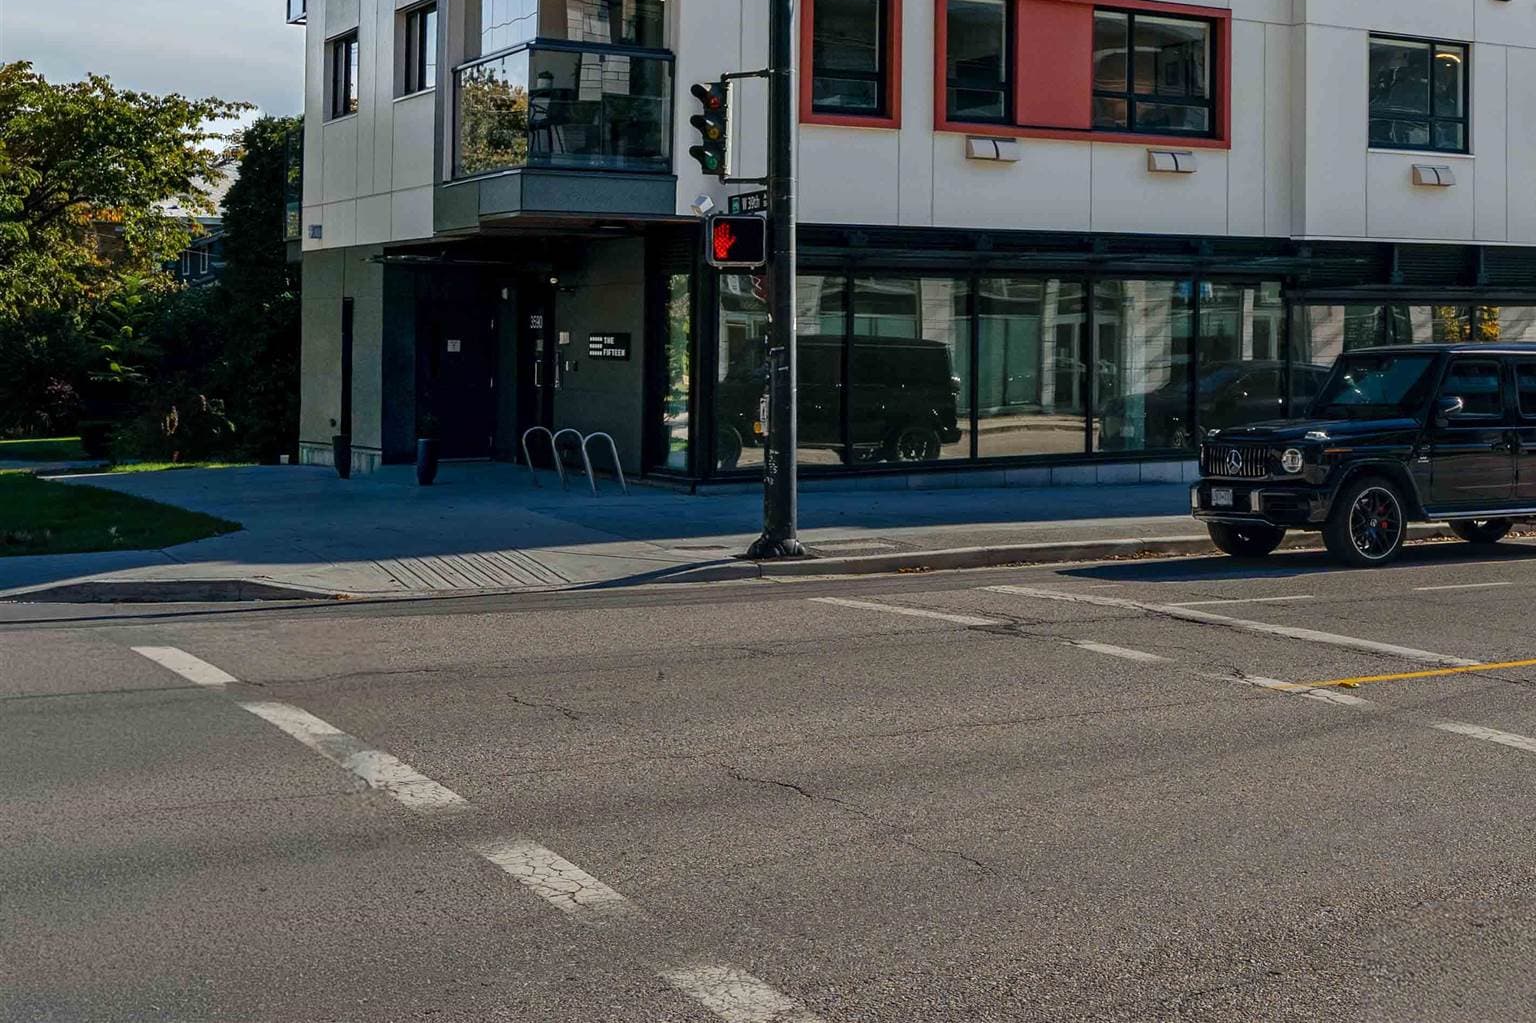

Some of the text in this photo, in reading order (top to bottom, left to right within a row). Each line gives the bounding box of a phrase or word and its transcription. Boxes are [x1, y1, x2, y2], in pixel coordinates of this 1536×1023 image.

[741, 197, 747, 211] W
[748, 194, 760, 210] 39th
[603, 336, 615, 345] THE
[603, 349, 626, 357] FIFTEEN
